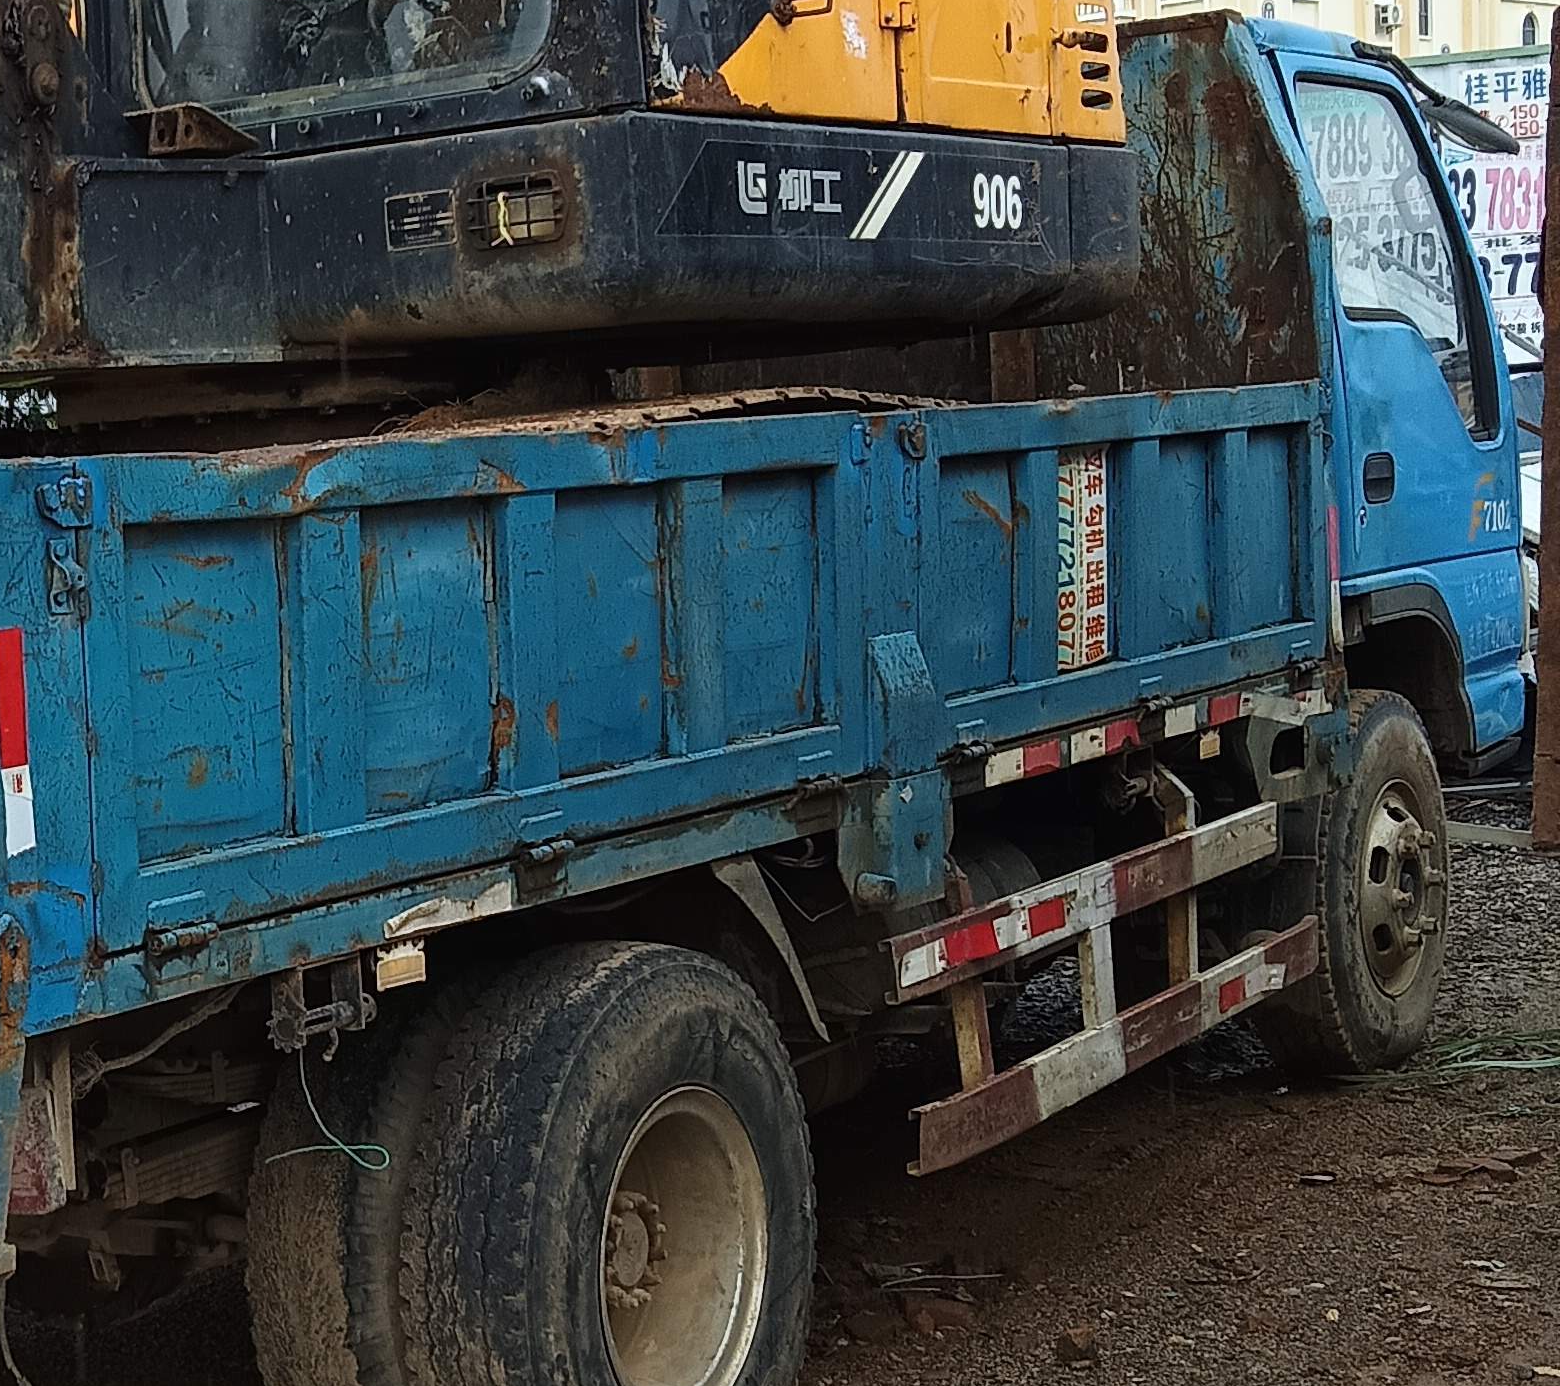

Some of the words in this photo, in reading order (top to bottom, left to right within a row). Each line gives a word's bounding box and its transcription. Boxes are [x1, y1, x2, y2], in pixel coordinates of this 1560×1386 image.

[778, 168, 842, 213] 柳工
[973, 173, 1022, 229] 906
[1085, 504, 1105, 554] 勾机
[1085, 561, 1105, 610] 出租
